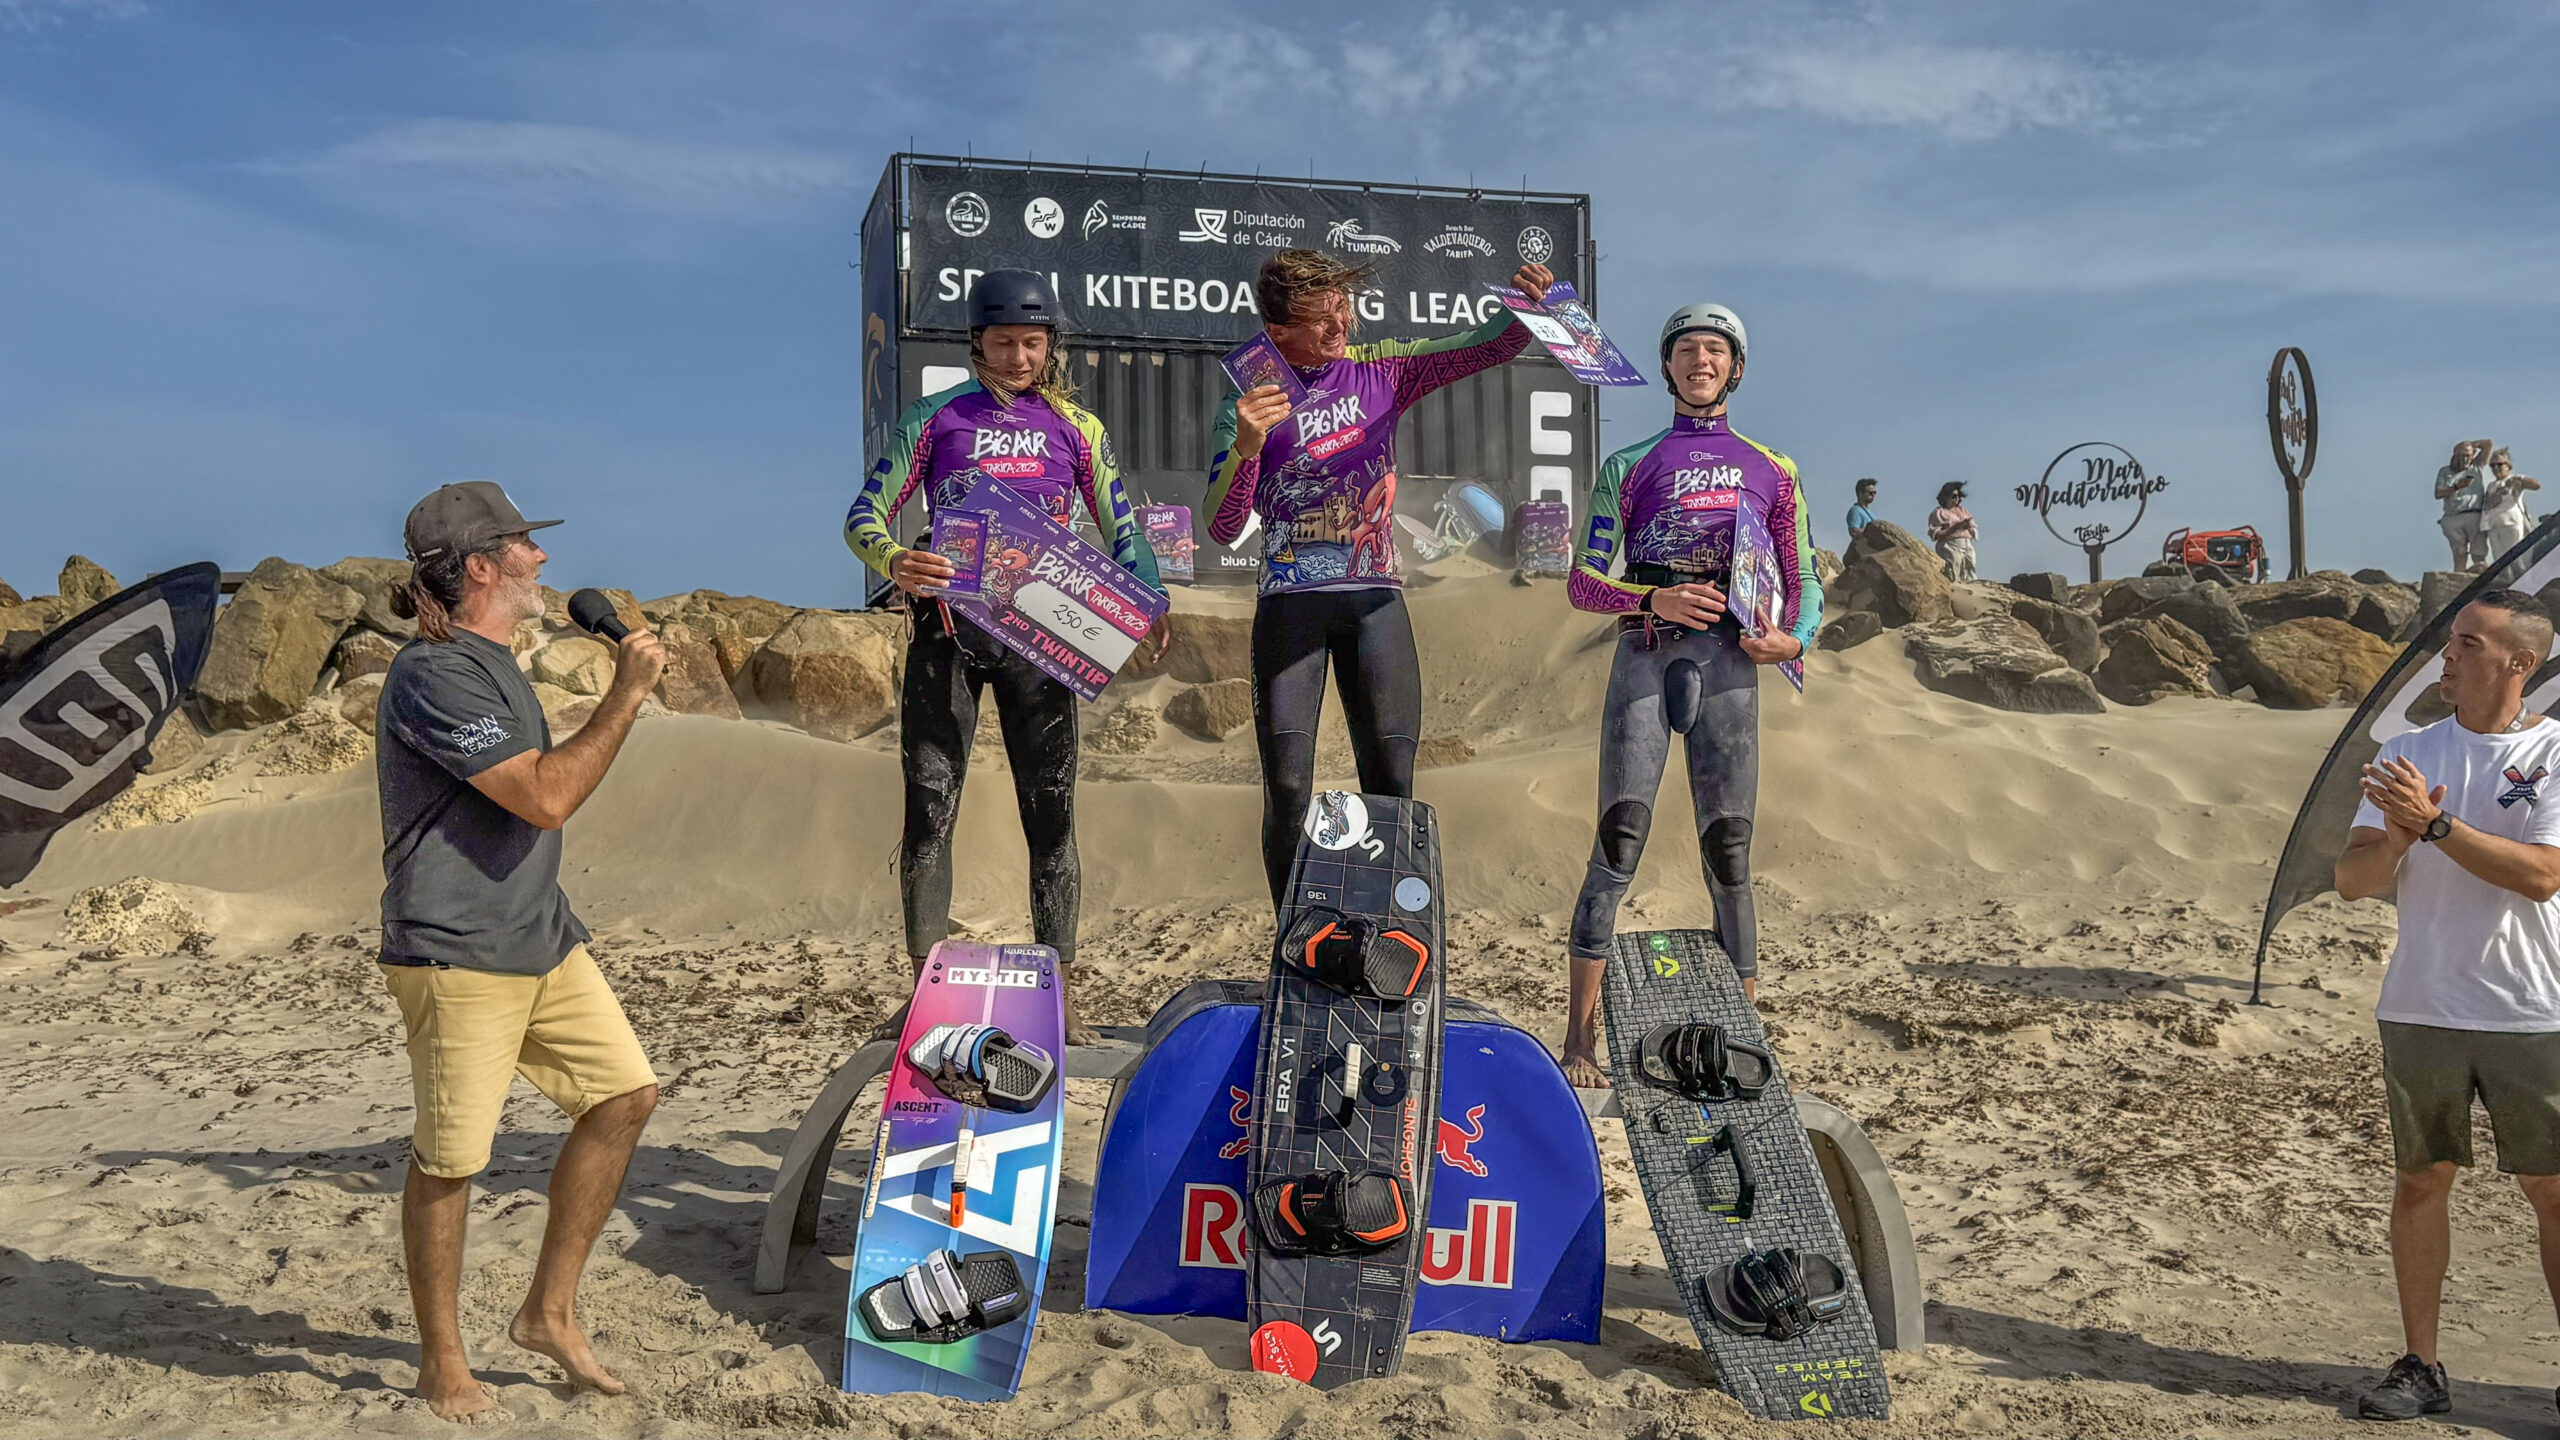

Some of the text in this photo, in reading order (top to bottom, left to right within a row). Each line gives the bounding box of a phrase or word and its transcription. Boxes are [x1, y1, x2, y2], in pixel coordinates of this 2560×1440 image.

[1233, 210, 1305, 229] Diputación
[1233, 230, 1292, 248] de Cádiz
[1423, 232, 1496, 257] VALDEVAQUEROS
[1346, 242, 1390, 255] TUMBAO
[1445, 248, 1474, 259] TARIFA
[2082, 457, 2143, 483] Mar
[2015, 475, 2171, 516] Mediterráneo
[2074, 524, 2110, 542] Tarifa
[1221, 555, 1246, 567] blue
[1052, 604, 1104, 641] 250 €
[999, 609, 1110, 687] 2ND TWINTIP
[451, 714, 499, 742] SPAIN
[457, 731, 486, 749] WING
[462, 731, 512, 758] LEAGUE
[1307, 891, 1328, 901] 136
[951, 969, 1035, 985] MYSTIC
[1276, 1037, 1297, 1114] ERA V1
[893, 1100, 942, 1114] ASCENT
[1400, 1097, 1418, 1183] SLINGSHOT
[1420, 1201, 1516, 1288] ull
[1775, 1359, 1863, 1373] SERIES
[1801, 1370, 1868, 1382] TEAM
